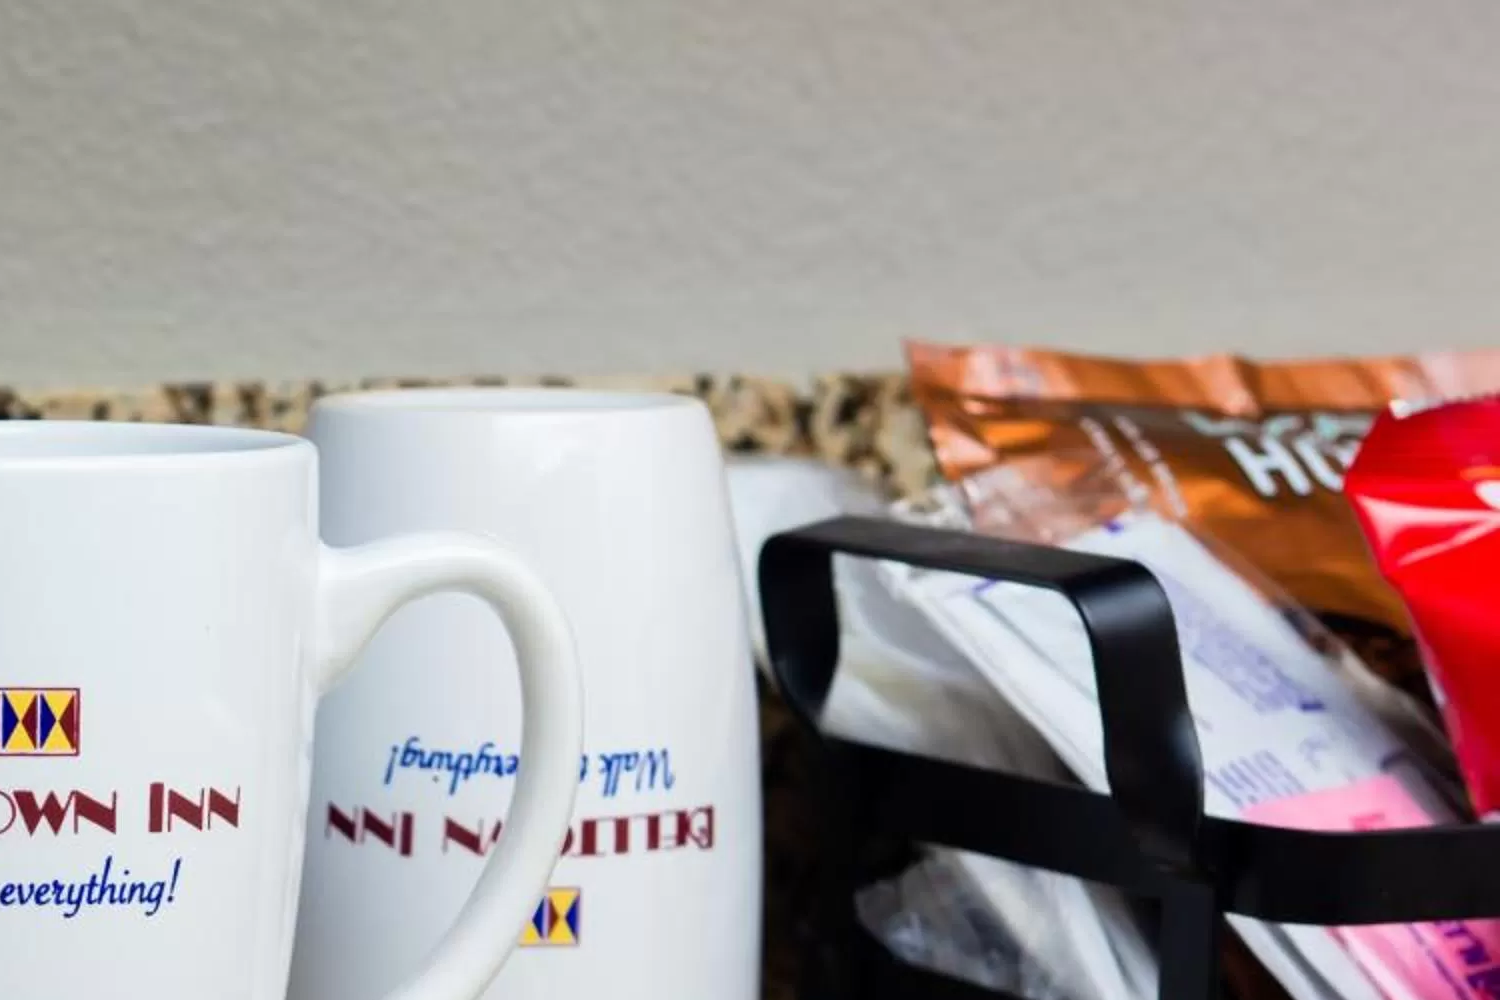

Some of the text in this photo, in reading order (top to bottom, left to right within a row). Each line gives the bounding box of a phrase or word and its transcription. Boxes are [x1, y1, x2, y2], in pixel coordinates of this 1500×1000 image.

[383, 736, 520, 796] erything!
[598, 748, 676, 797] Walk
[148, 782, 241, 832] INN
[324, 801, 714, 858] BELLTN INN
